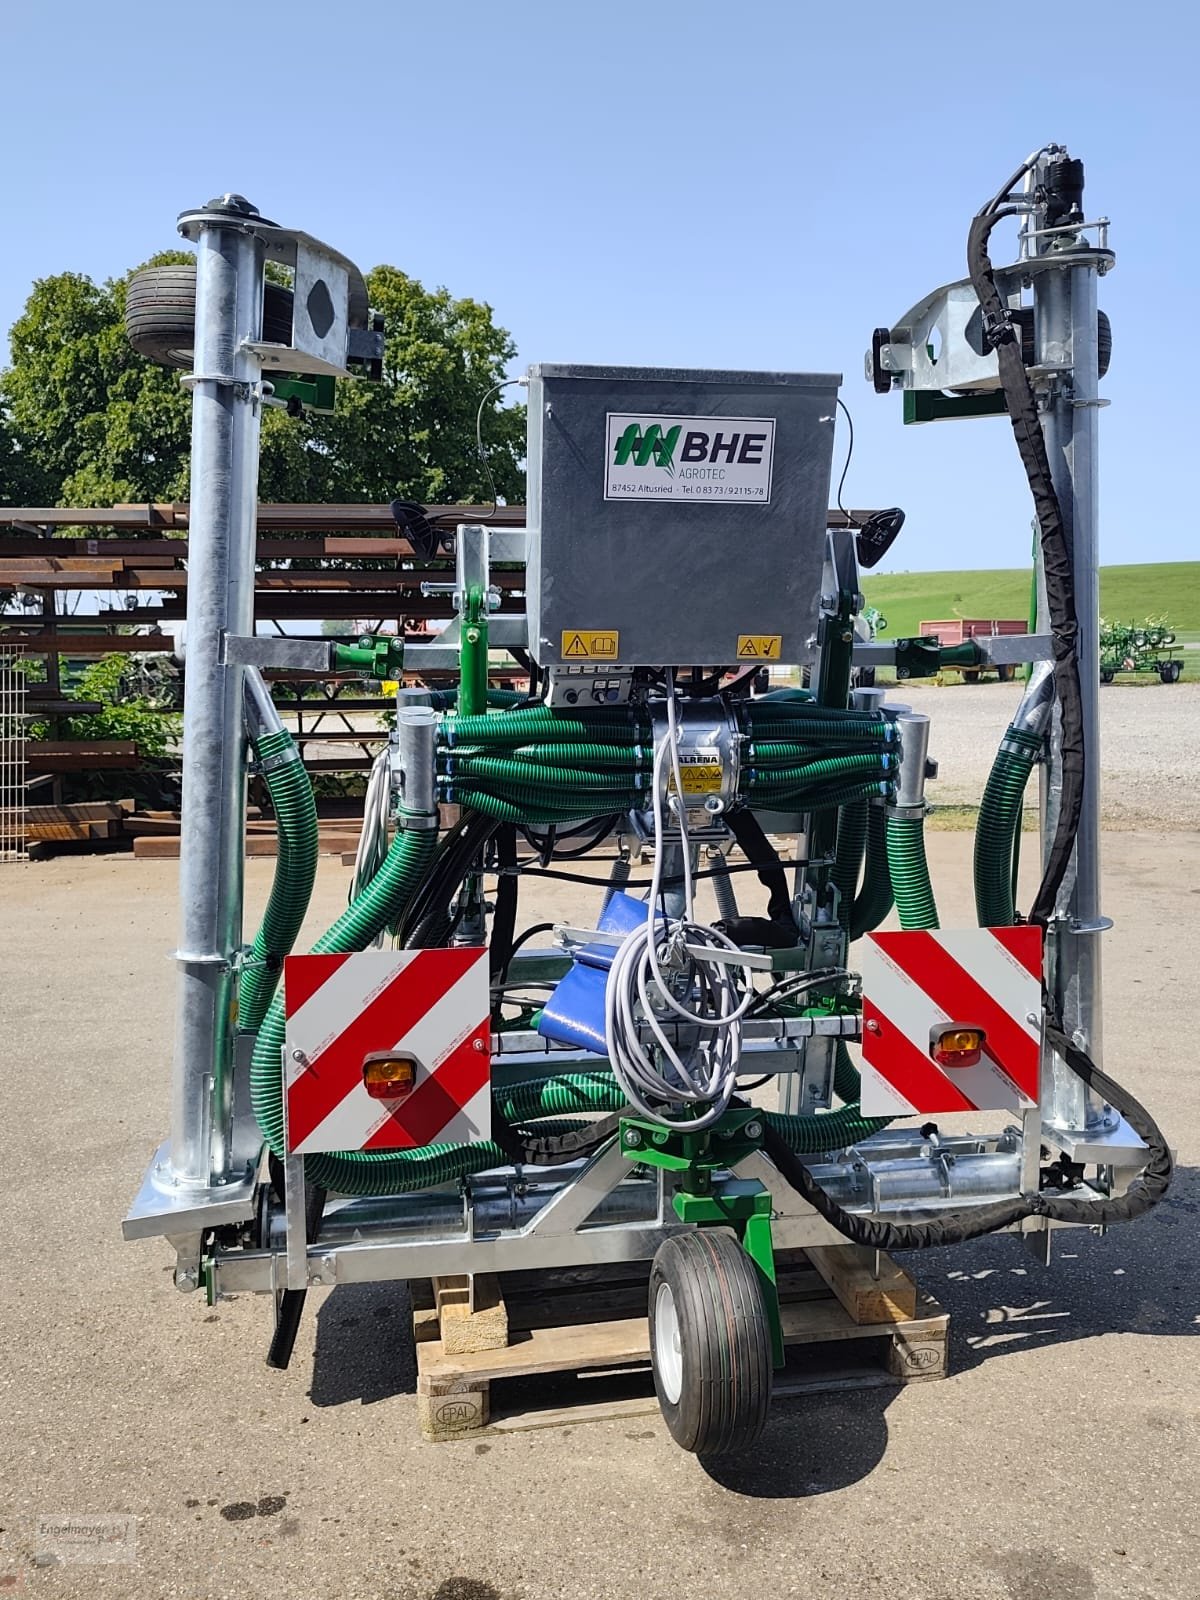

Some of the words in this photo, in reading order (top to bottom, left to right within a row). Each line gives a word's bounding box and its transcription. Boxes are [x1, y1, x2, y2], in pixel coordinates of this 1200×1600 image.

[680, 431, 767, 464] BHE
[678, 468, 726, 480] AGROTEC
[612, 484, 636, 492] 87452
[638, 484, 673, 493] Altusried
[682, 485, 694, 494] Tel.
[911, 1352, 934, 1365] EPAL
[442, 1405, 471, 1421] EPAL
